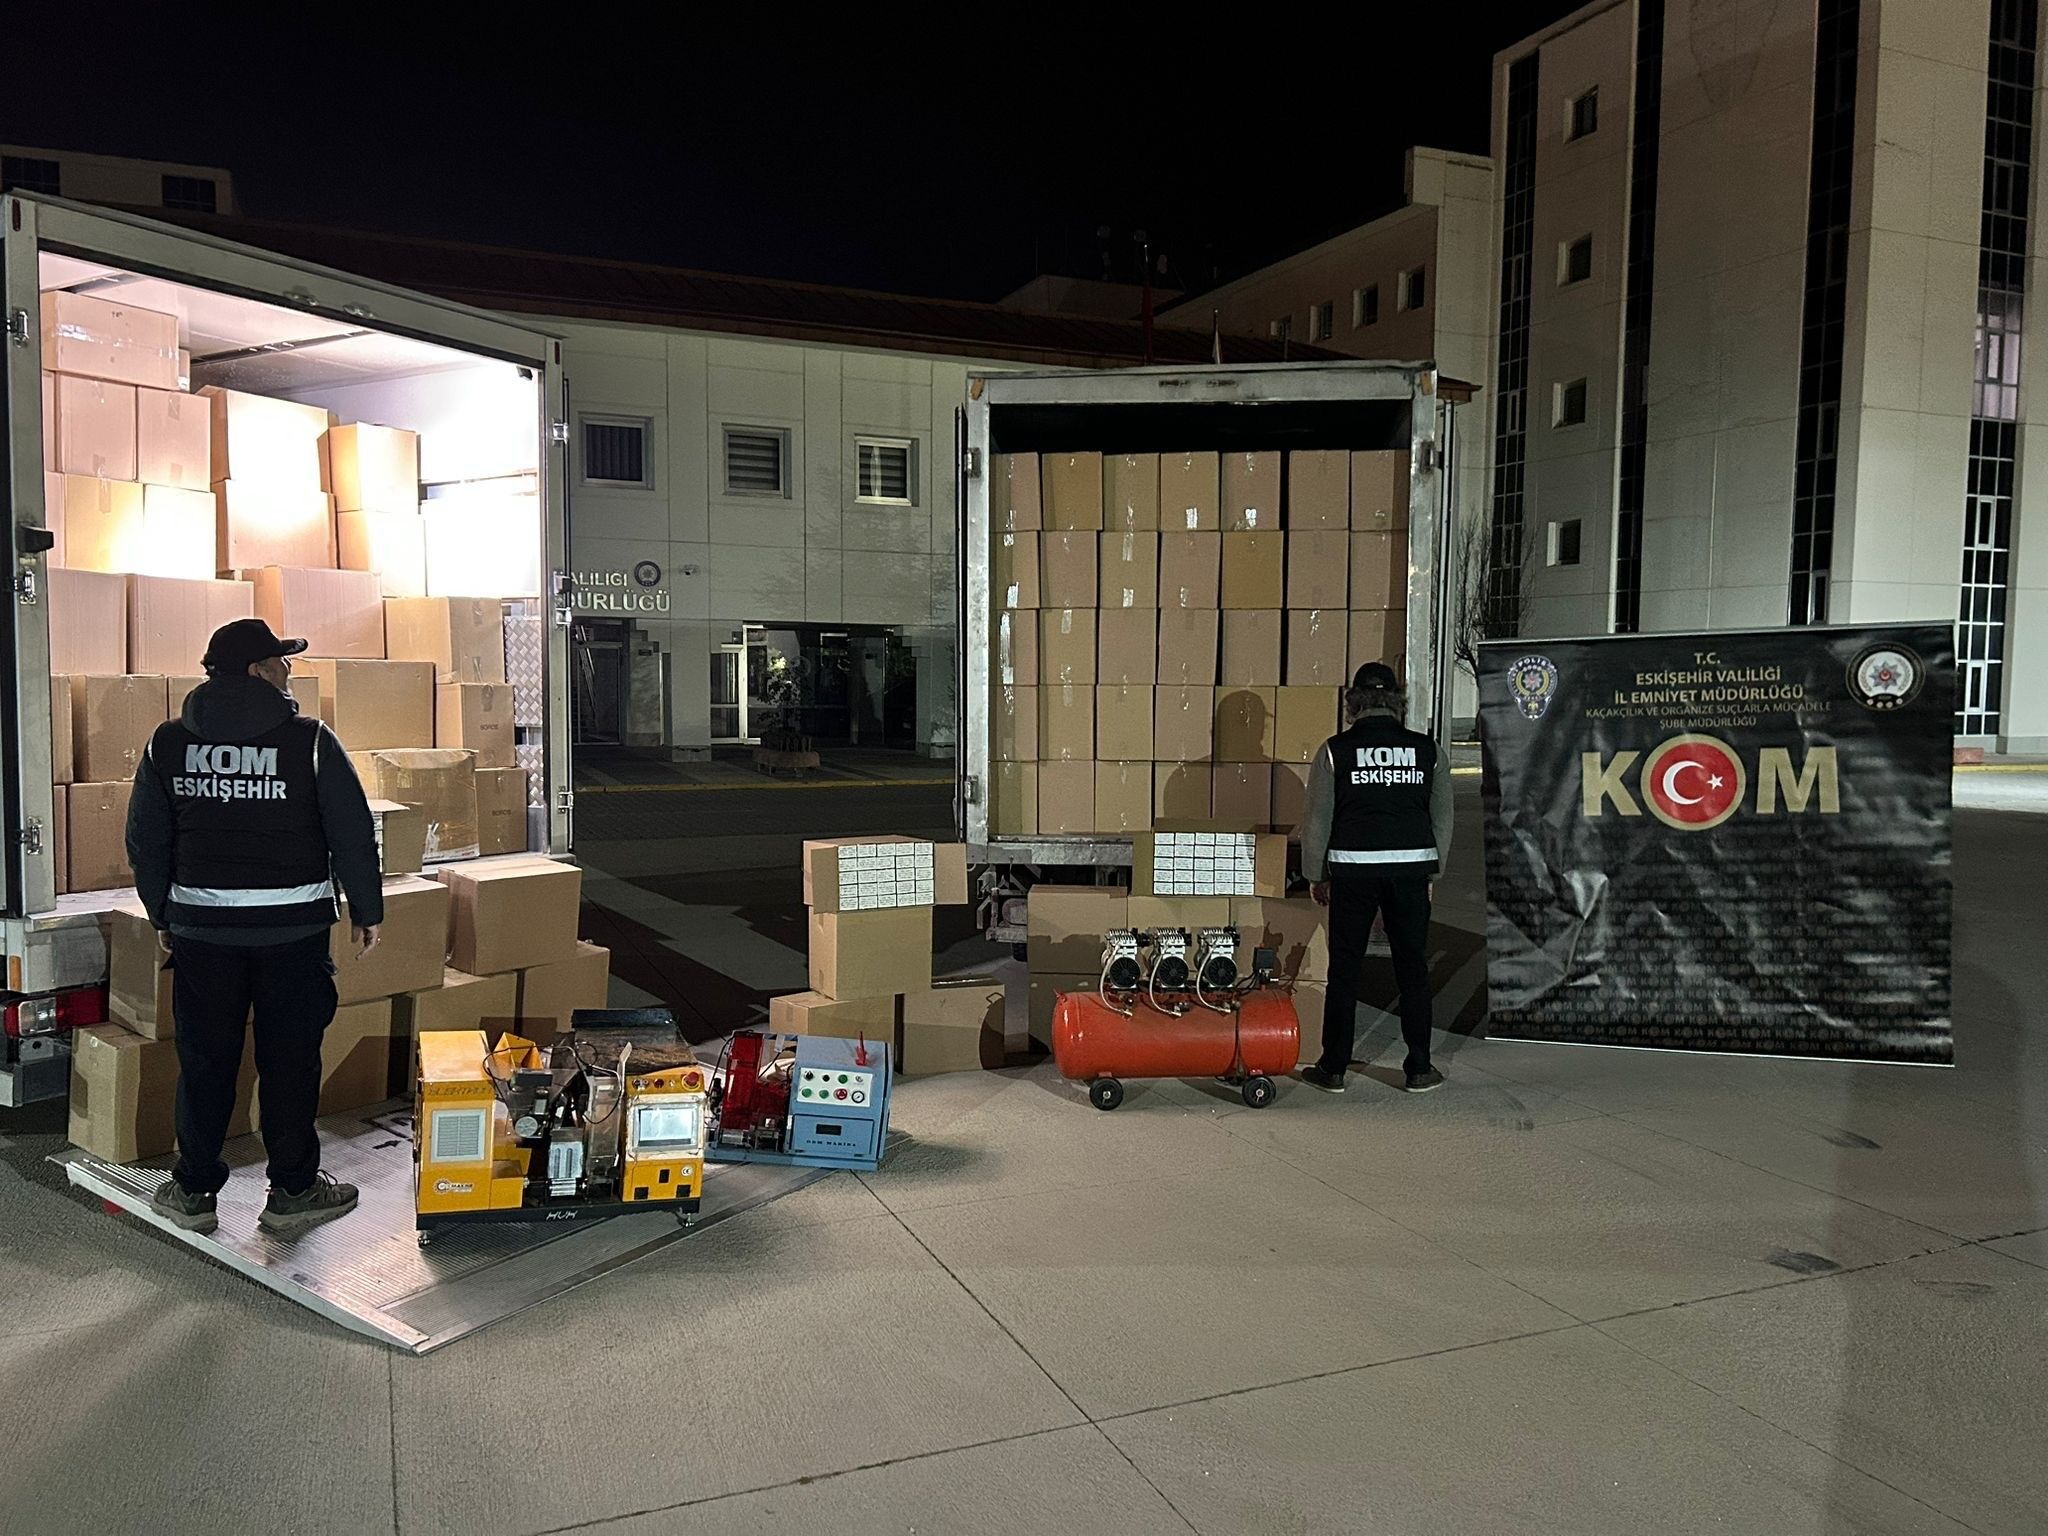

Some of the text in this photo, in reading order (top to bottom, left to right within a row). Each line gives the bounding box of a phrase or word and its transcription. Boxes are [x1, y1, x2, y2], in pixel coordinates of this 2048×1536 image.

[1694, 652, 1721, 665] T.C.
[1636, 665, 1781, 687] ESKİŞEHİR VALİLİĞİ
[1615, 684, 1804, 704] İL EMNİYET MÜDÜRLÜĞÜ
[1647, 706, 1658, 717] VE
[1717, 702, 1770, 715] SUÇLARLA
[185, 744, 278, 775] KOM
[1356, 747, 1416, 767] KOM
[1350, 766, 1424, 786] ESKİŞEHİR
[172, 773, 287, 803] ESKİŞEHİR
